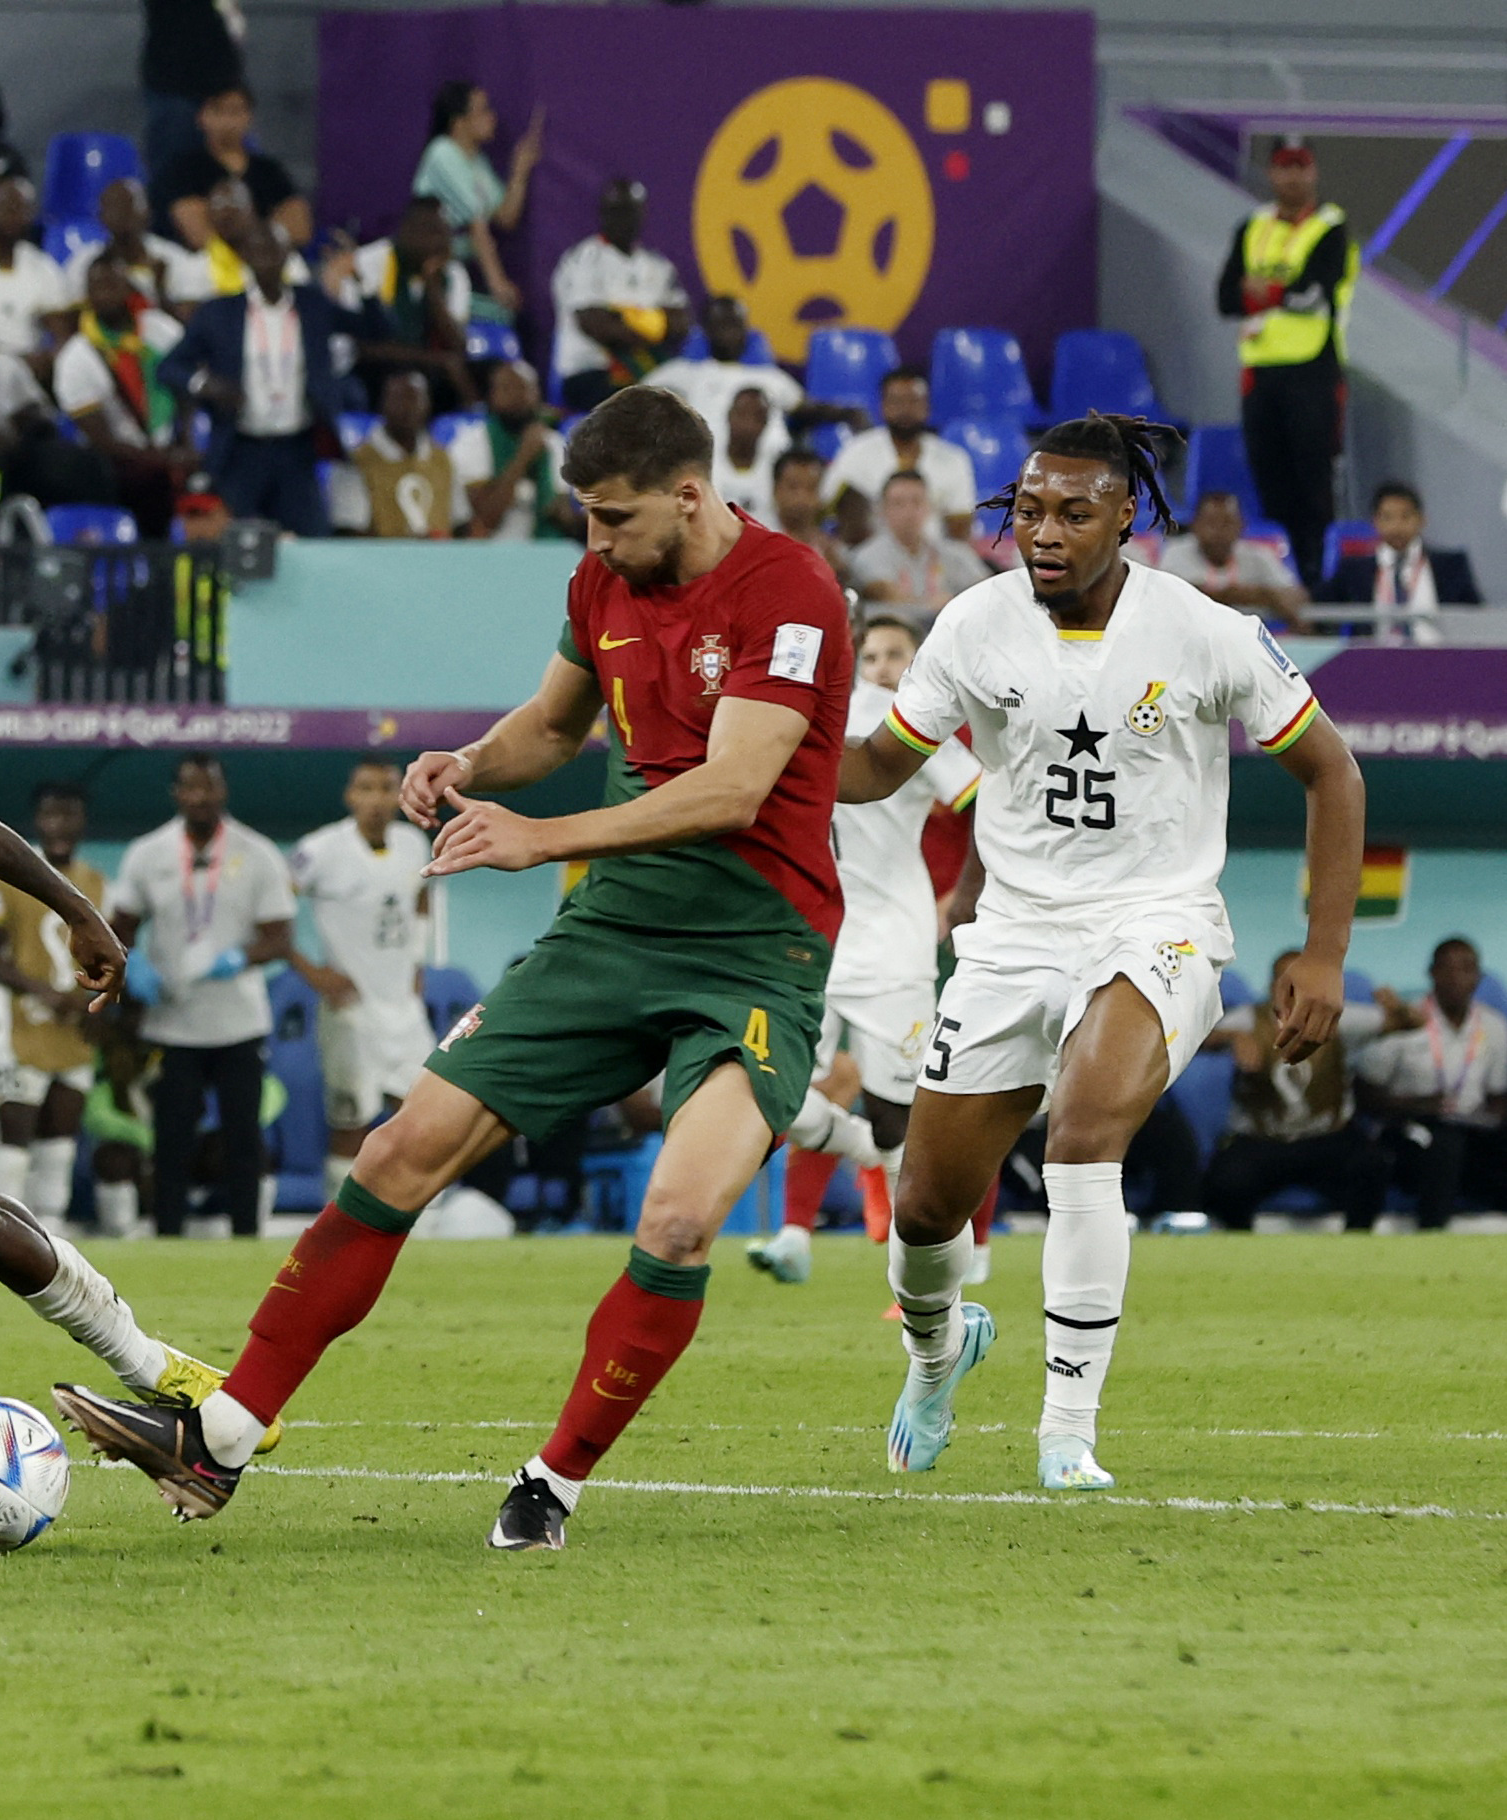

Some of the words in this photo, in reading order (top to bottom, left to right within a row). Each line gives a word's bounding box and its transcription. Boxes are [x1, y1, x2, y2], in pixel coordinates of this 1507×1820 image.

[51, 710, 102, 741] CUP
[219, 711, 291, 742] 2022
[1394, 722, 1442, 754] CUP
[1045, 763, 1116, 831] 25
[742, 1007, 771, 1062] 4
[924, 1011, 962, 1082] 5
